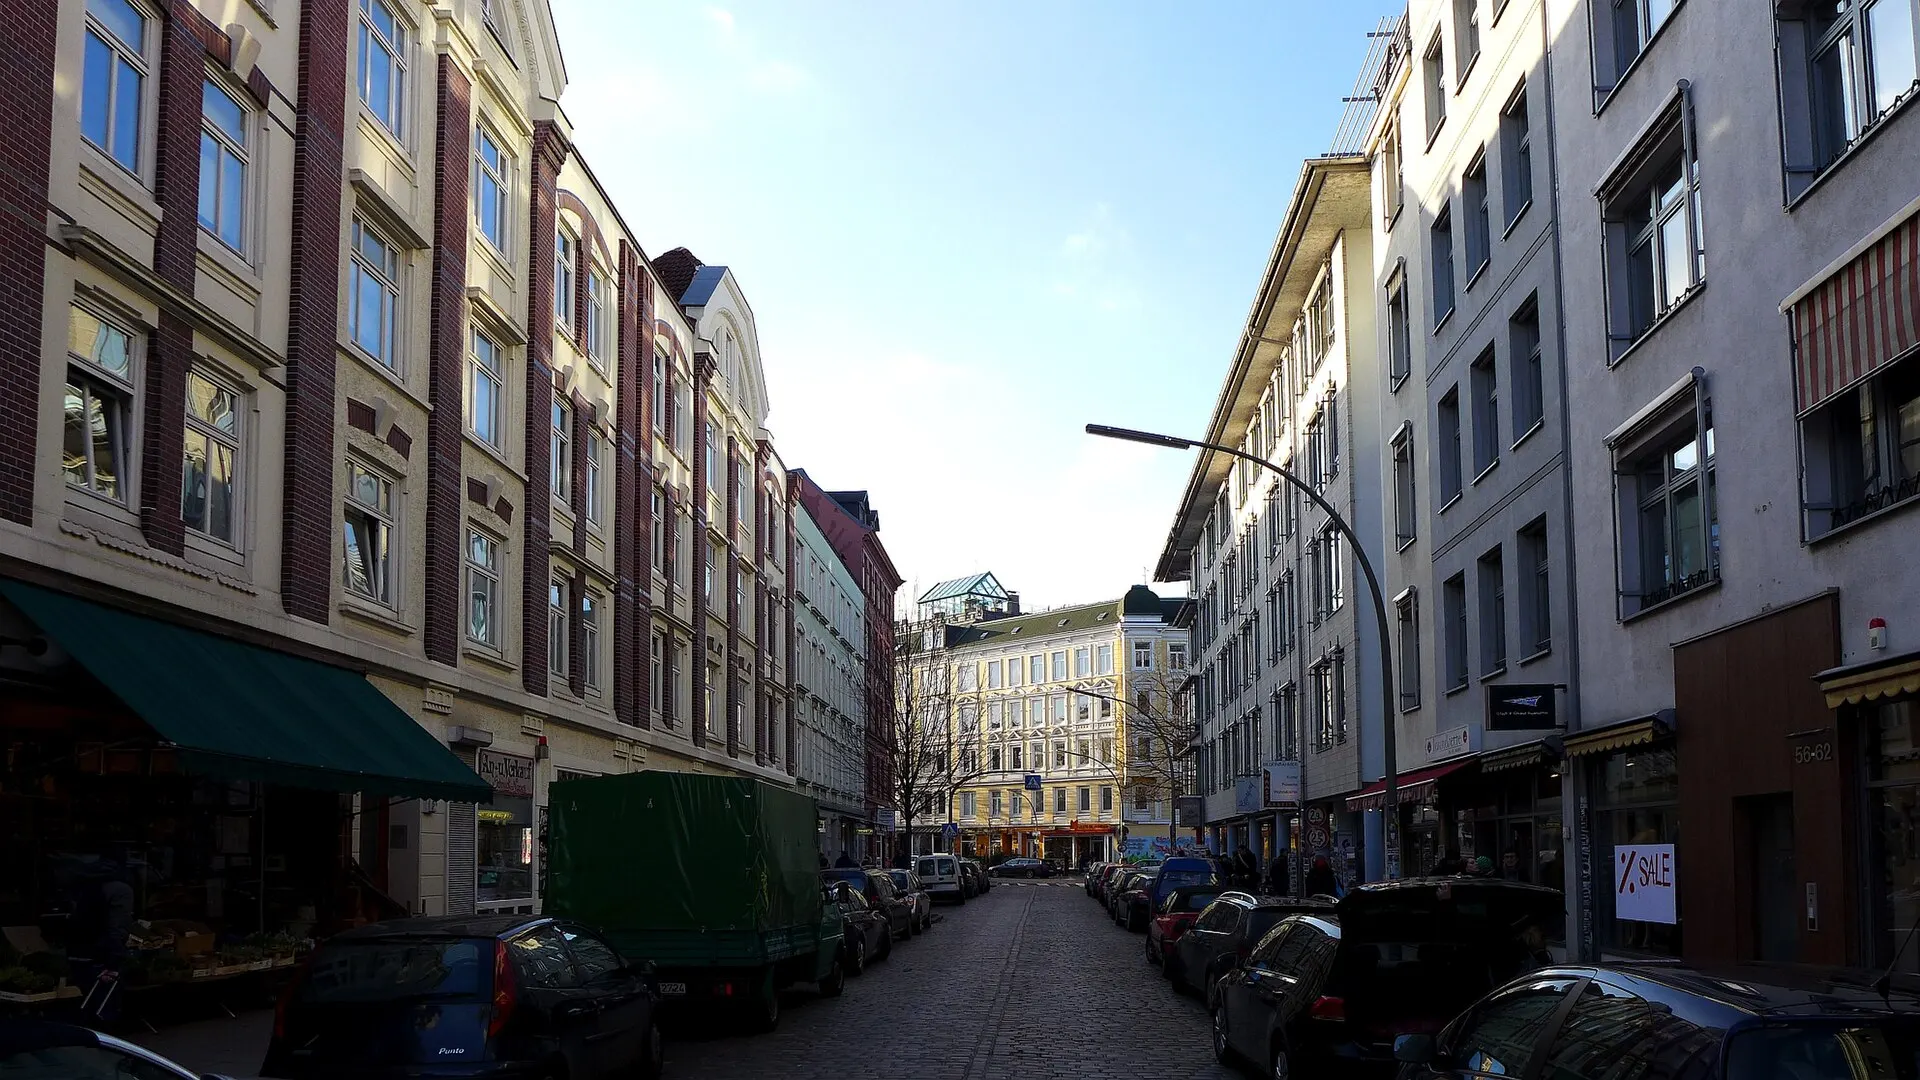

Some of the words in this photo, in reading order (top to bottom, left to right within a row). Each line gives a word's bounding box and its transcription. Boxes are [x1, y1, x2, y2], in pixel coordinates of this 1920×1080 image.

[1795, 743, 1831, 764] 56-62
[1639, 853, 1671, 887] SALE
[438, 1047, 465, 1055] Punto
